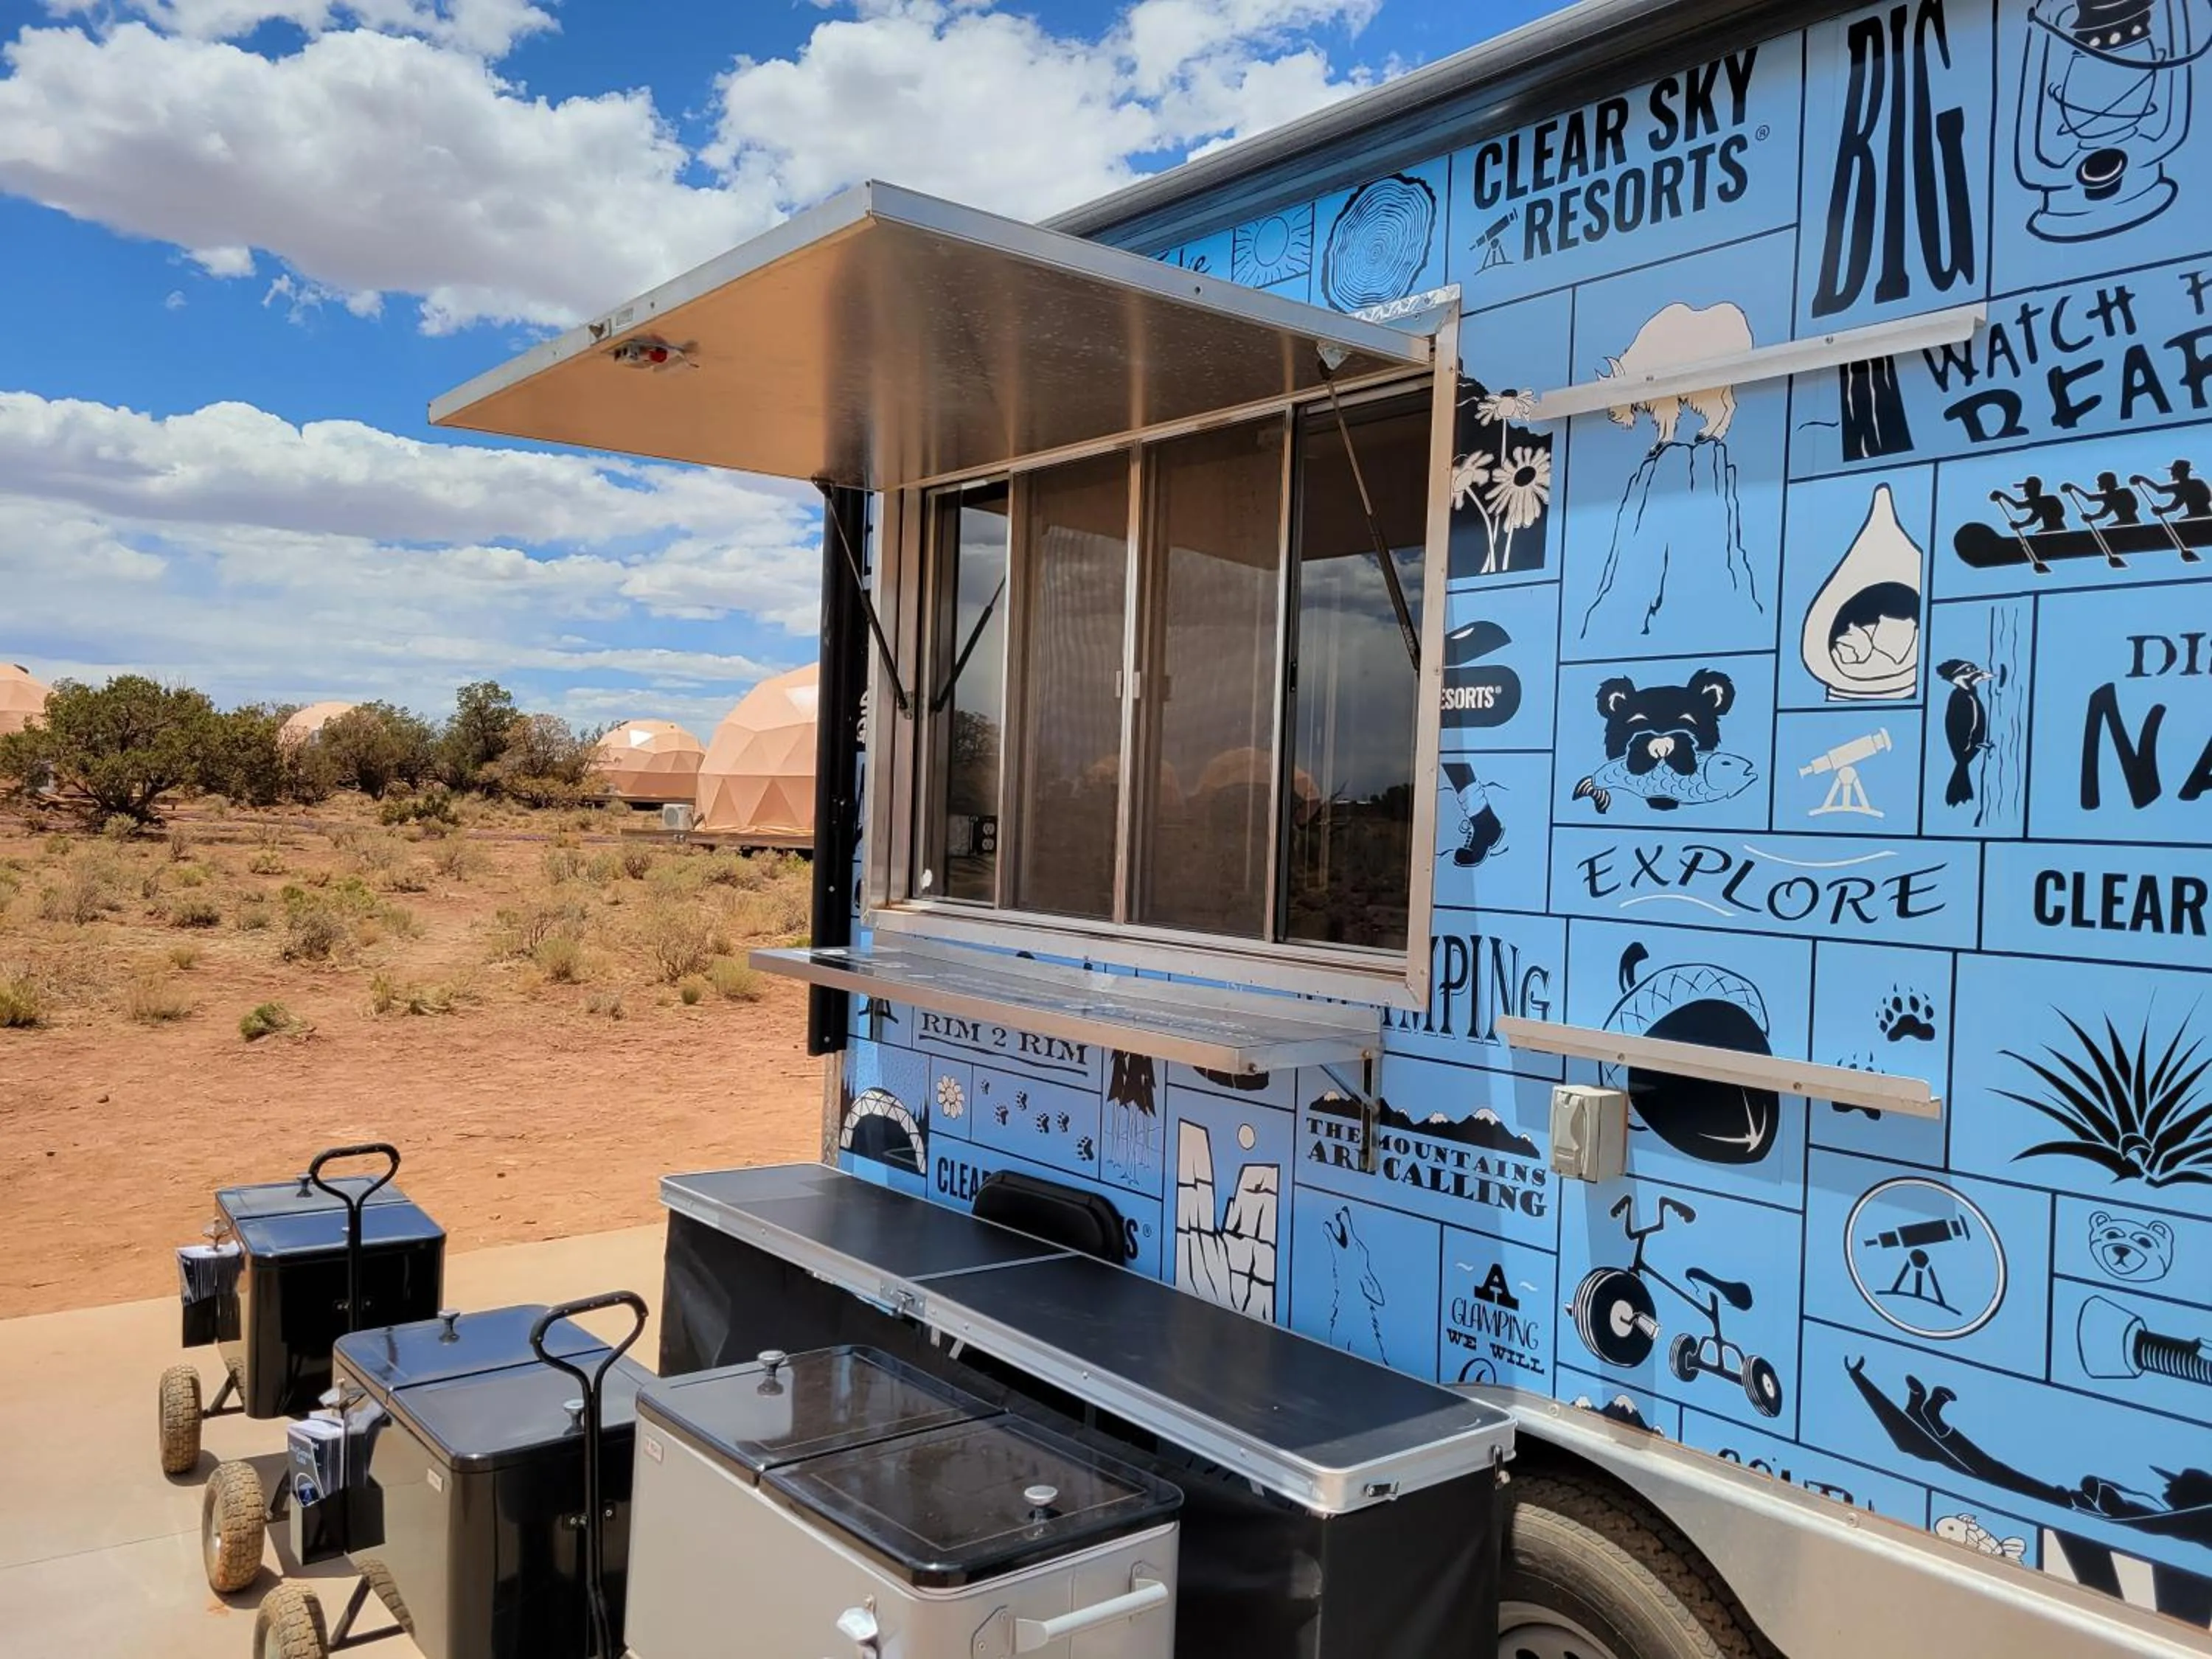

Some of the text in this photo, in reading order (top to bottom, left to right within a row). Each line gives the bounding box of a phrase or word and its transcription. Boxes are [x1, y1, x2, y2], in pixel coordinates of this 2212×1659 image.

[1473, 45, 1759, 210] CLEAR SKY
[1812, 0, 1975, 319] BIG
[1921, 285, 2137, 393] WATCH
[2125, 632, 2212, 678] DI
[1576, 844, 1948, 925] EXPLORE
[2033, 869, 2208, 936] CLEAR
[921, 1012, 1089, 1065] RIM 2 RIM
[1306, 1116, 1360, 1144] THE
[1382, 1155, 1548, 1218] CALLING
[1473, 1262, 1520, 1312] A
[1446, 1327, 1478, 1352] WE
[1489, 1341, 1545, 1376] WILL
[1451, 1296, 1540, 1351] GLAMPING
